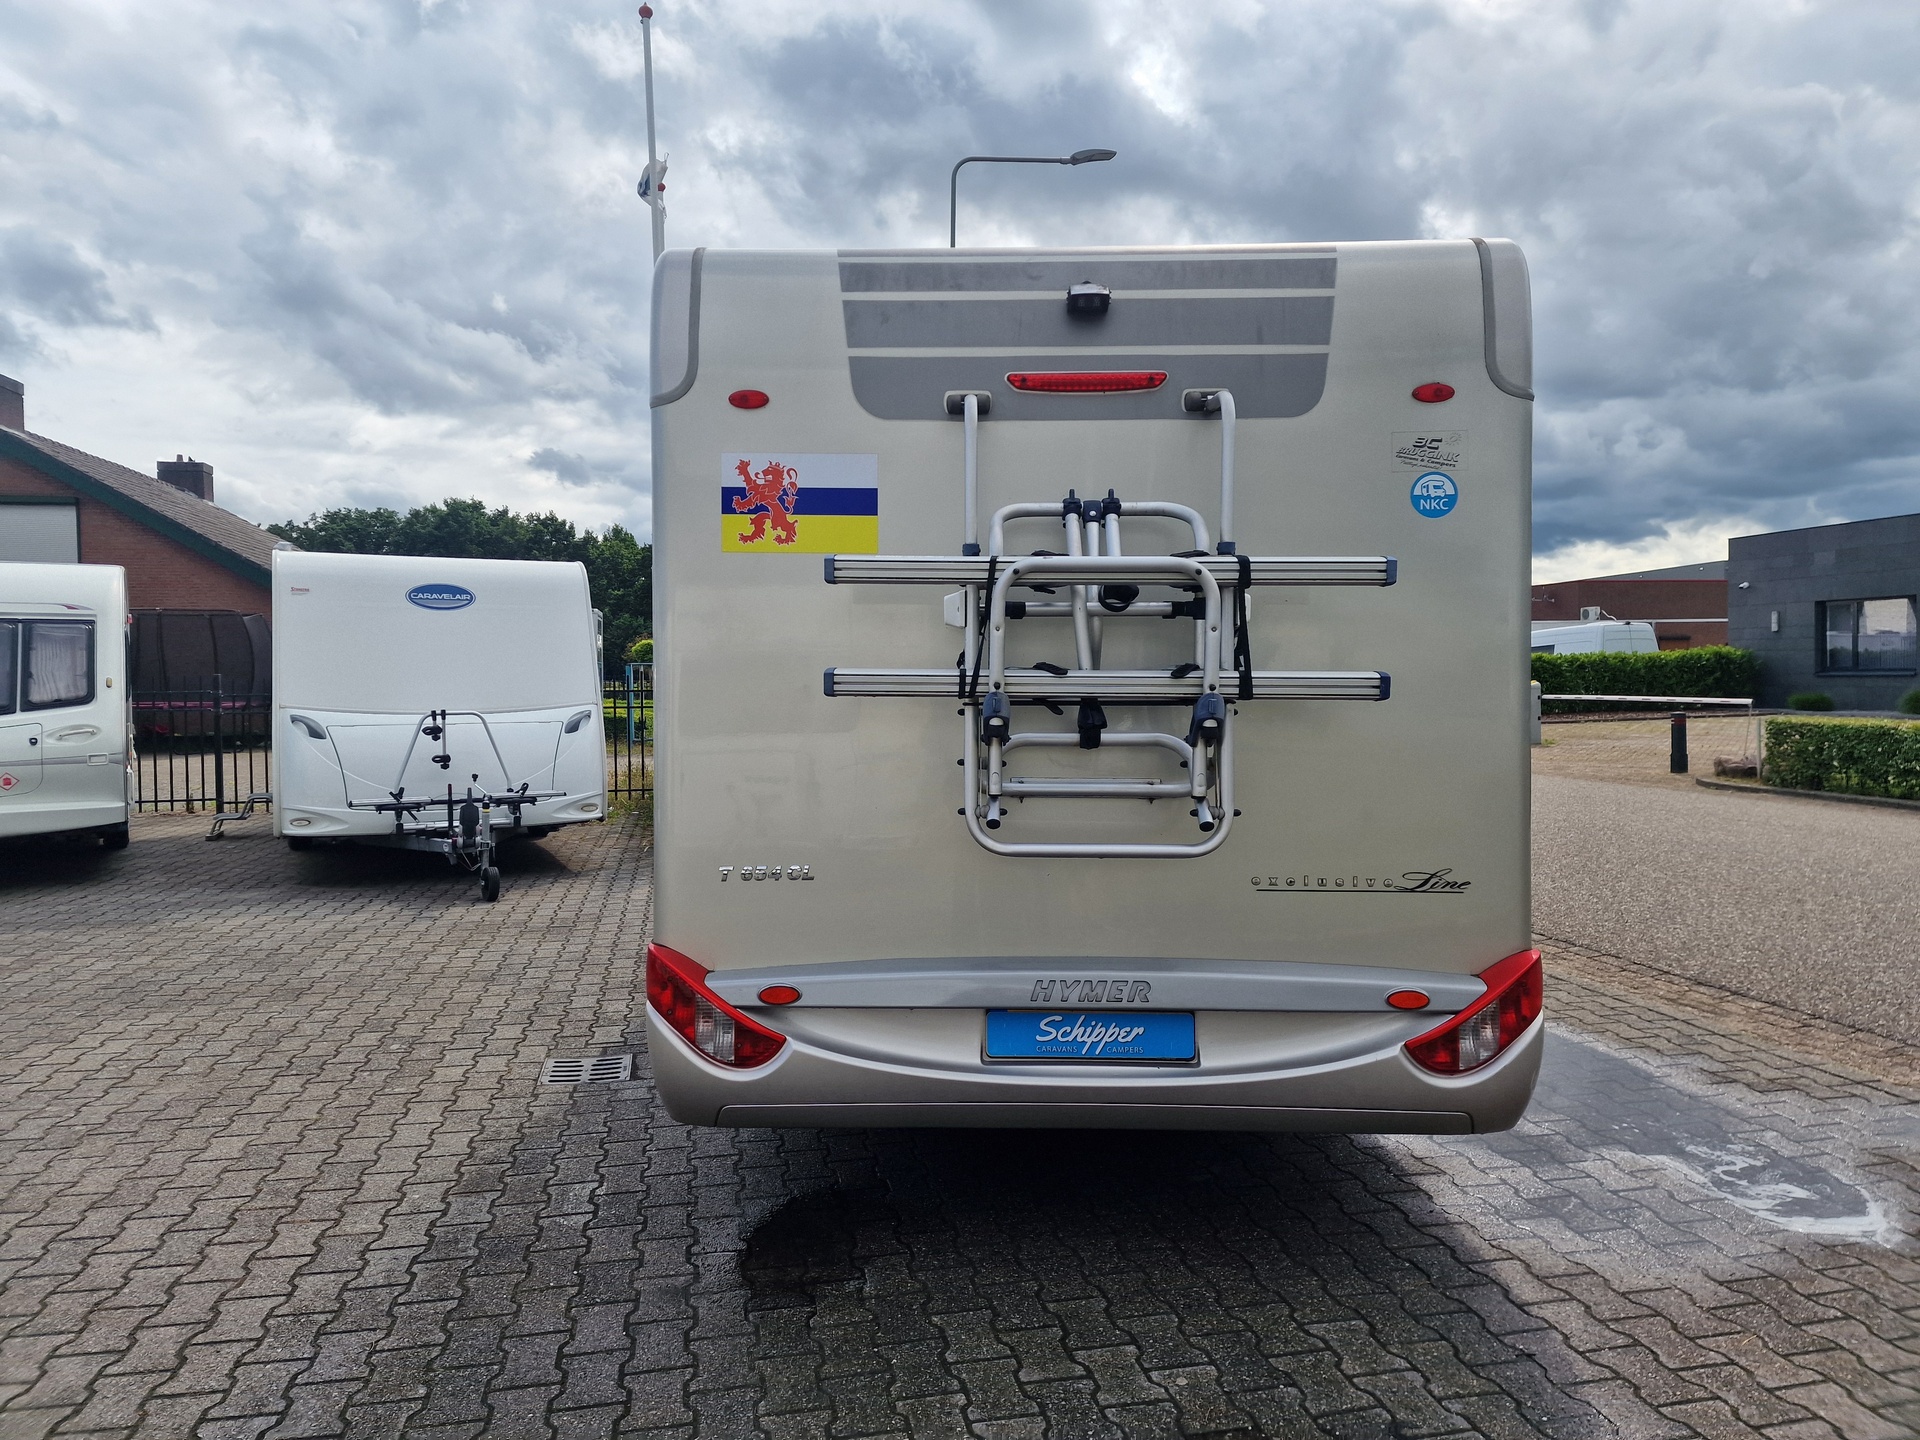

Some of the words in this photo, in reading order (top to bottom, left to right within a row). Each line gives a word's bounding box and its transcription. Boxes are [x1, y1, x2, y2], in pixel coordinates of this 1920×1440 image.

[1396, 447, 1460, 463] BRUGGINK
[1420, 498, 1449, 510] NKC
[410, 592, 471, 600] CARAVELAIR
[719, 865, 735, 882] T
[741, 865, 782, 881] 654
[787, 864, 815, 881] CL
[1251, 874, 1394, 888] exclusive
[1394, 868, 1471, 892] Line
[1030, 979, 1152, 1003] HYMER
[1036, 1014, 1145, 1055] Schipper
[1036, 1045, 1078, 1053] CARAVANS
[1106, 1046, 1144, 1054] CAMPERS
